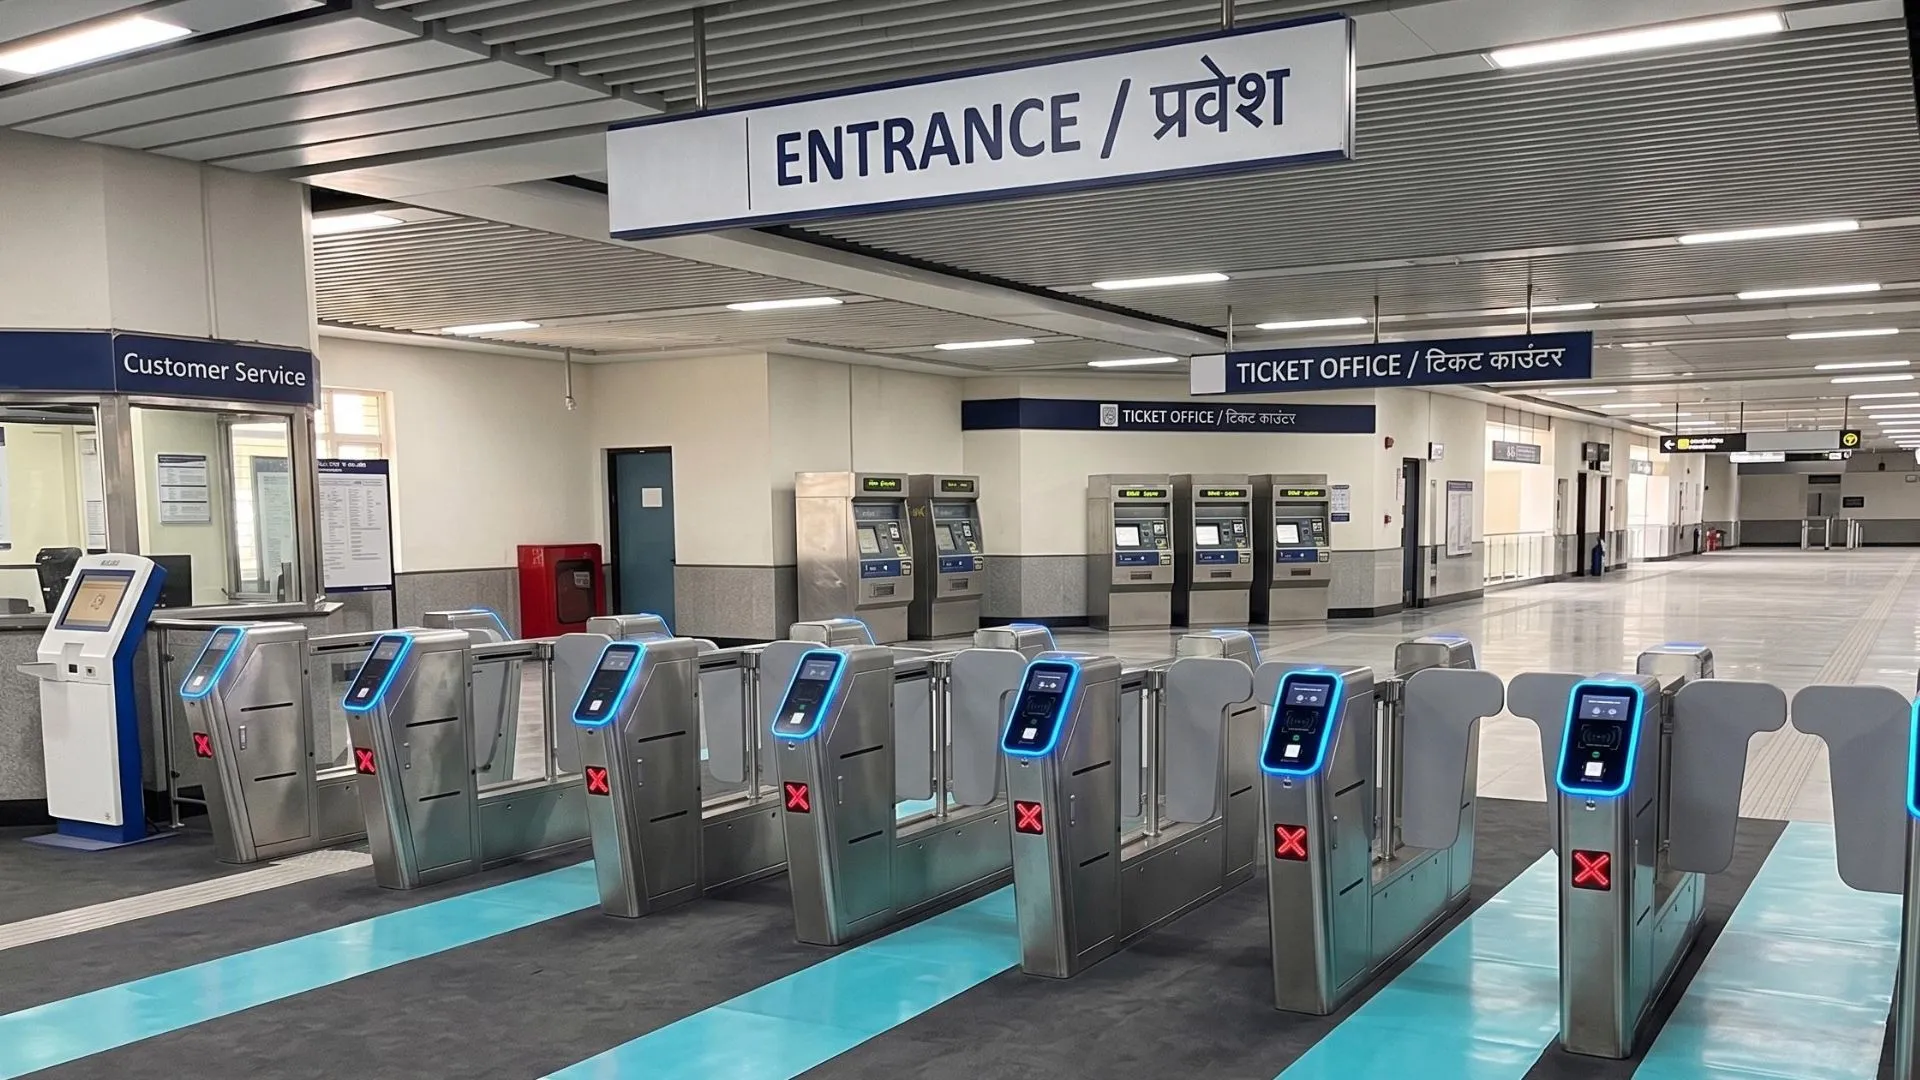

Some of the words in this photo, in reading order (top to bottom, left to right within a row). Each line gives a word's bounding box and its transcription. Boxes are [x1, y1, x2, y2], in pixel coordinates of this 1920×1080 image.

[776, 92, 1081, 186] ENTRANCE
[1100, 78, 1132, 160] /
[1148, 55, 1292, 140] प्रवेश
[123, 352, 230, 381] Customer
[235, 361, 307, 388] Service
[1236, 358, 1315, 384] TICKET
[1320, 354, 1402, 380] OFFICE
[1407, 350, 1421, 379] /
[1425, 348, 1485, 374] टिकट
[1489, 343, 1567, 370] काउंटर
[1123, 409, 1167, 424] TICKET
[1170, 409, 1215, 425] OFFICE
[1216, 409, 1224, 426] /
[1225, 408, 1257, 425] टिकट
[1258, 409, 1297, 425] काउंटर
